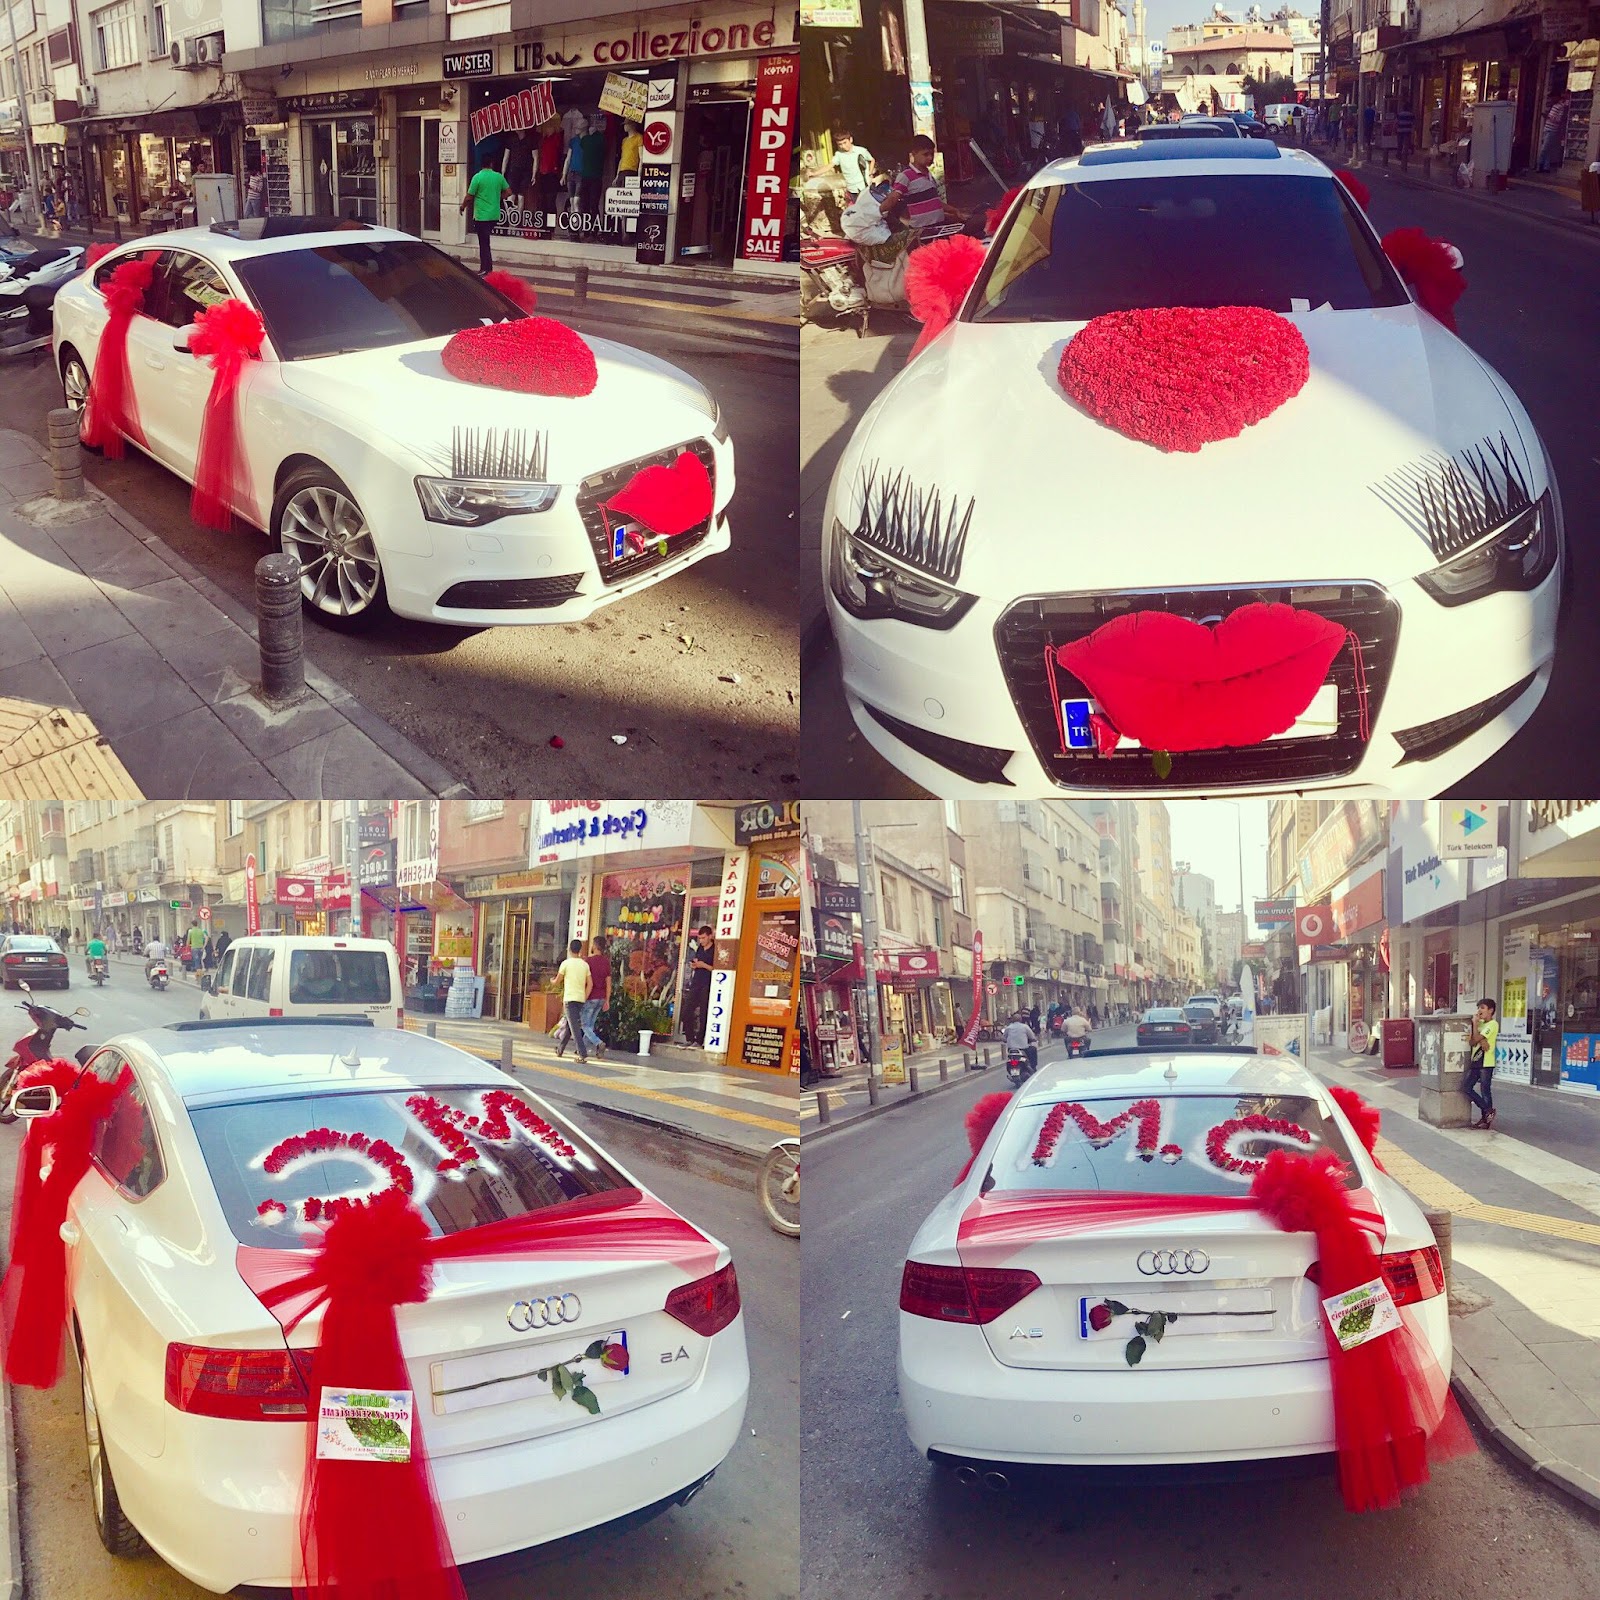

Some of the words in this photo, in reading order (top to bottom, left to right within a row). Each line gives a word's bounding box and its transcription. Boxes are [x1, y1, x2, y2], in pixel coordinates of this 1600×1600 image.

[593, 21, 775, 63] collezione
[514, 42, 545, 72] LTB
[644, 168, 659, 177] LTB
[559, 211, 622, 233] COBALT
[746, 238, 780, 254] SALE
[1072, 726, 1089, 737] TR
[1464, 843, 1493, 851] Telekom
[825, 896, 856, 904] LORIS
[1009, 1325, 1043, 1340] A5
